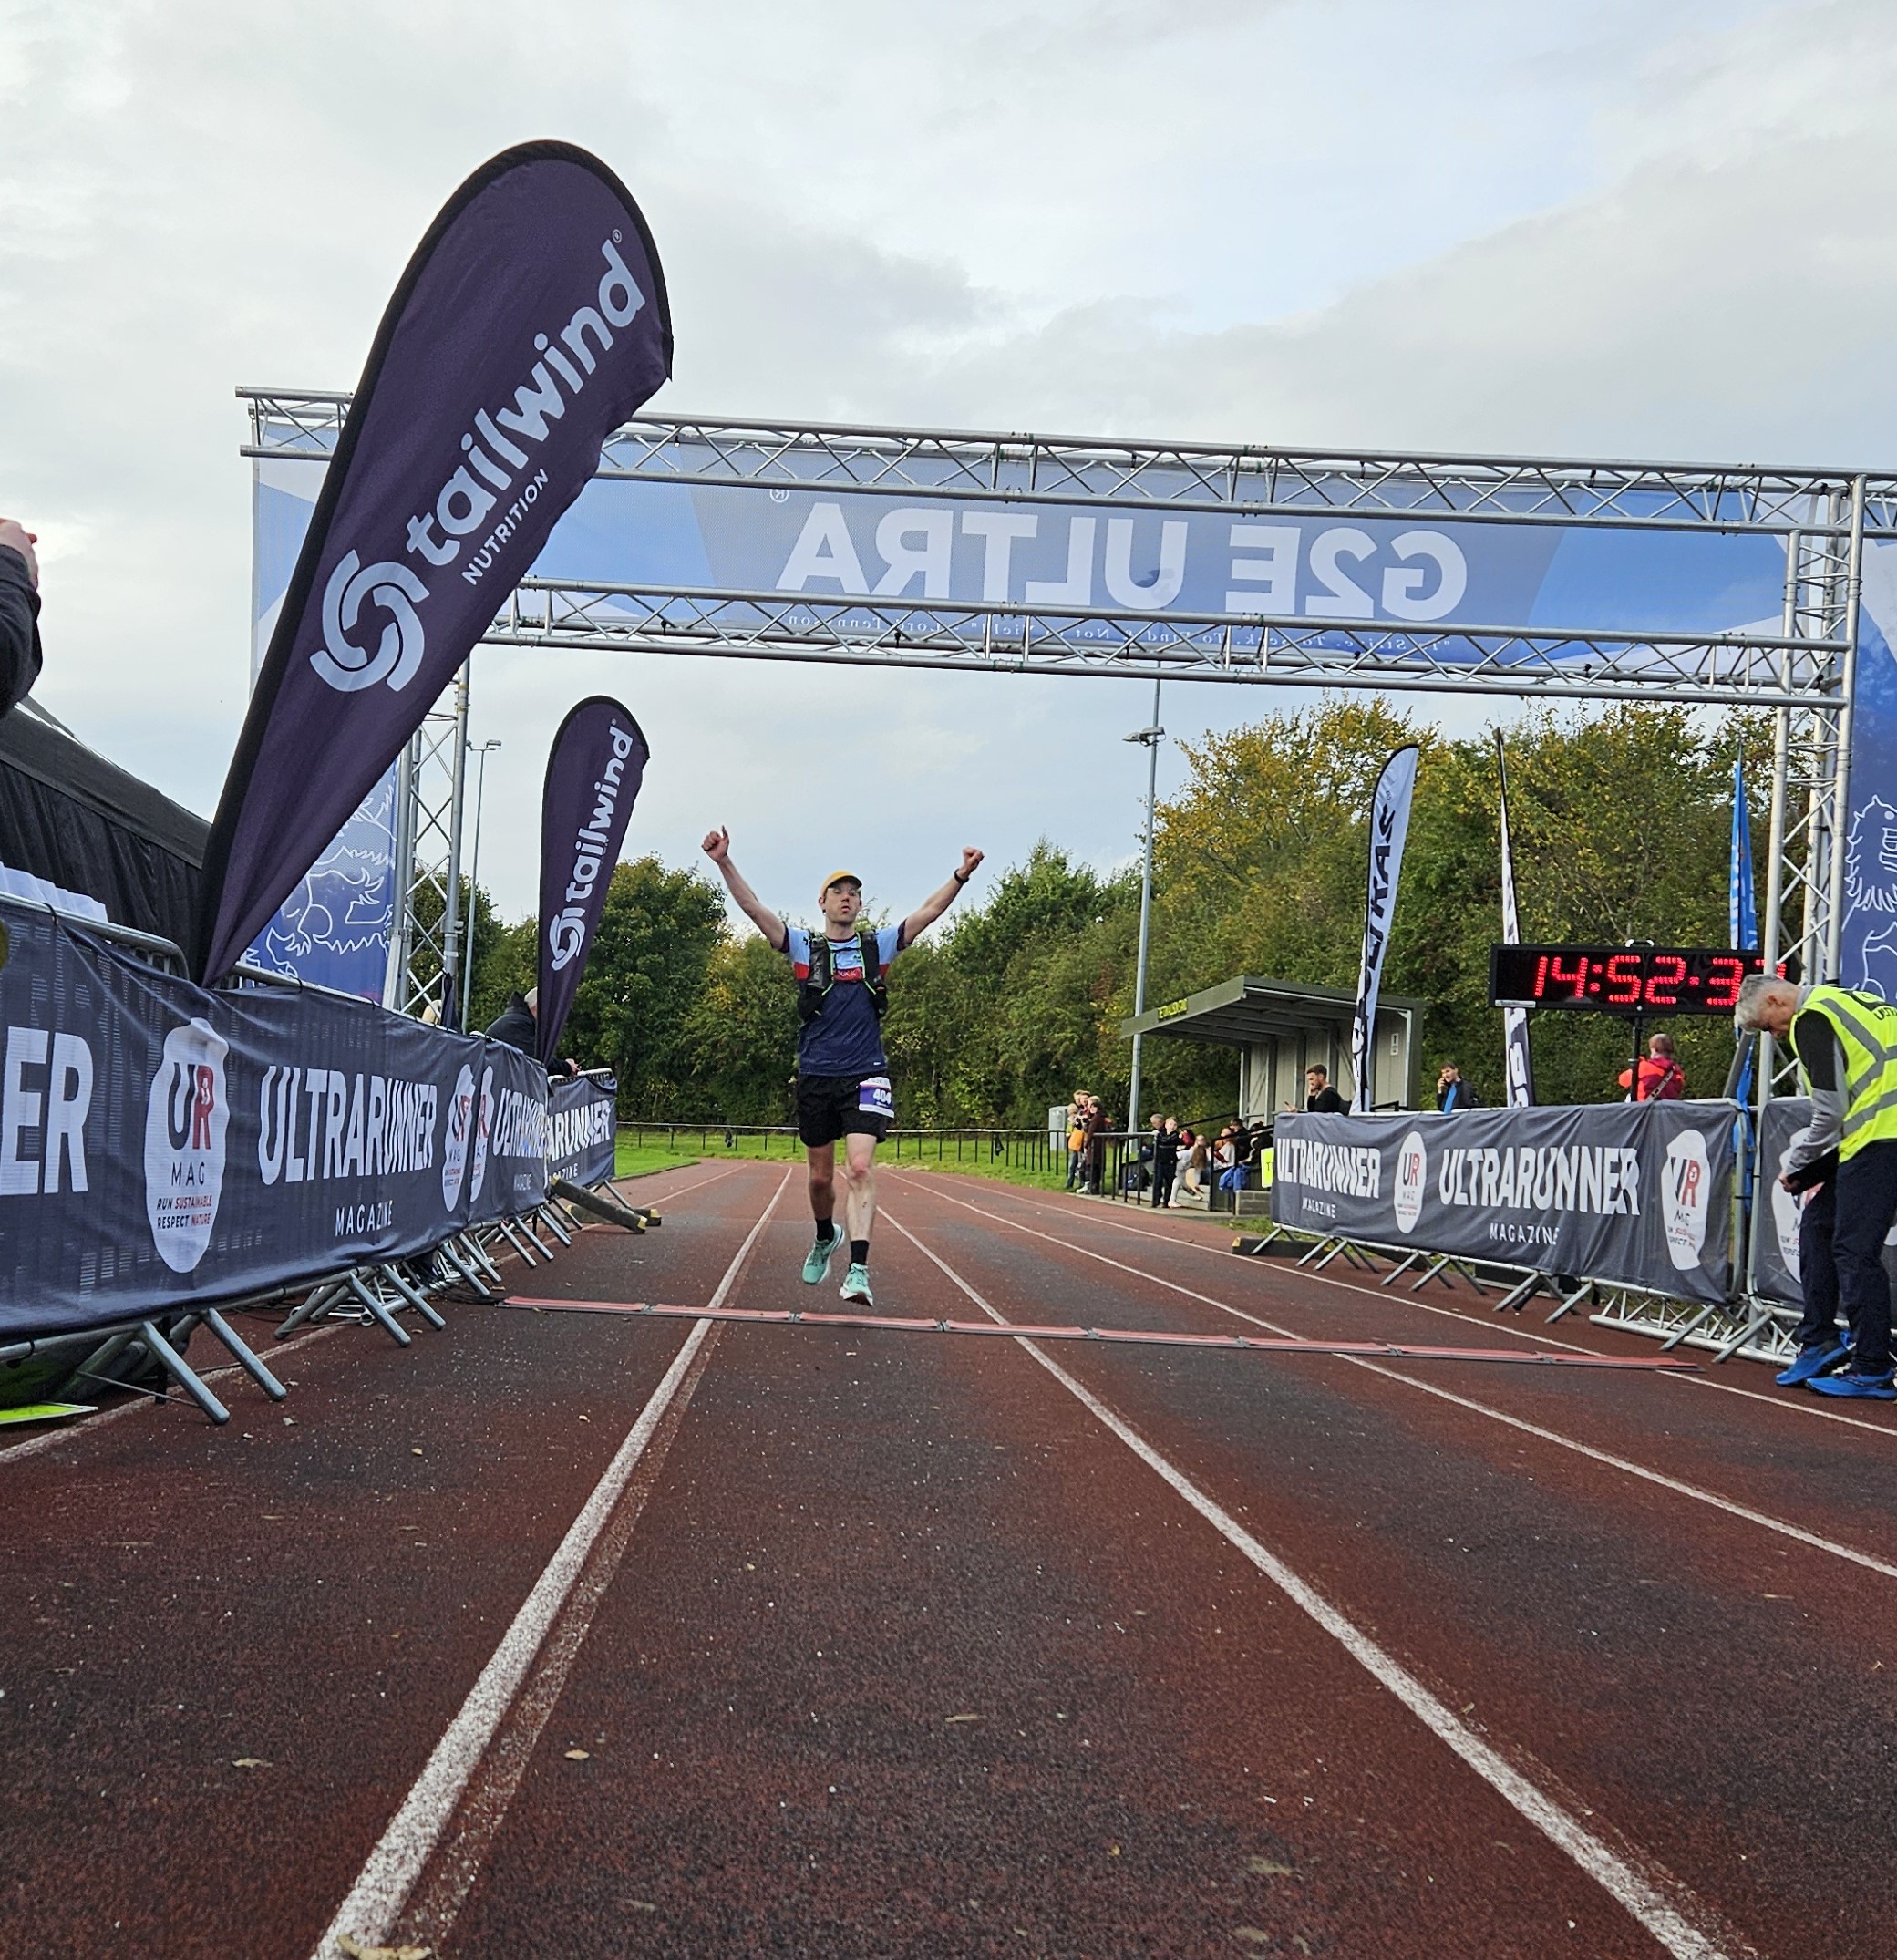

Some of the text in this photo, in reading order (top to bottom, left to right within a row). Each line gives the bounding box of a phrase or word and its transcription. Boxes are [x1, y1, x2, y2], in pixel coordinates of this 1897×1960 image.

[407, 239, 646, 566] tailwind
[461, 468, 549, 586] NUTRITION
[565, 726, 634, 906] tailwind
[168, 1062, 214, 1150] UR
[258, 1065, 438, 1185] ULTRARUNNER
[171, 1161, 205, 1186] MAG
[1277, 1138, 1381, 1199] ULTRARUNNER
[1403, 1153, 1420, 1186] UR
[1438, 1145, 1641, 1215] ULTRARUNNER
[156, 1195, 213, 1211] RUN SUSTAINABLE
[157, 1212, 211, 1230] RESPECT NATURE
[335, 1200, 394, 1237] MAGAZINE
[1490, 1222, 1560, 1245] MAGAZINE
